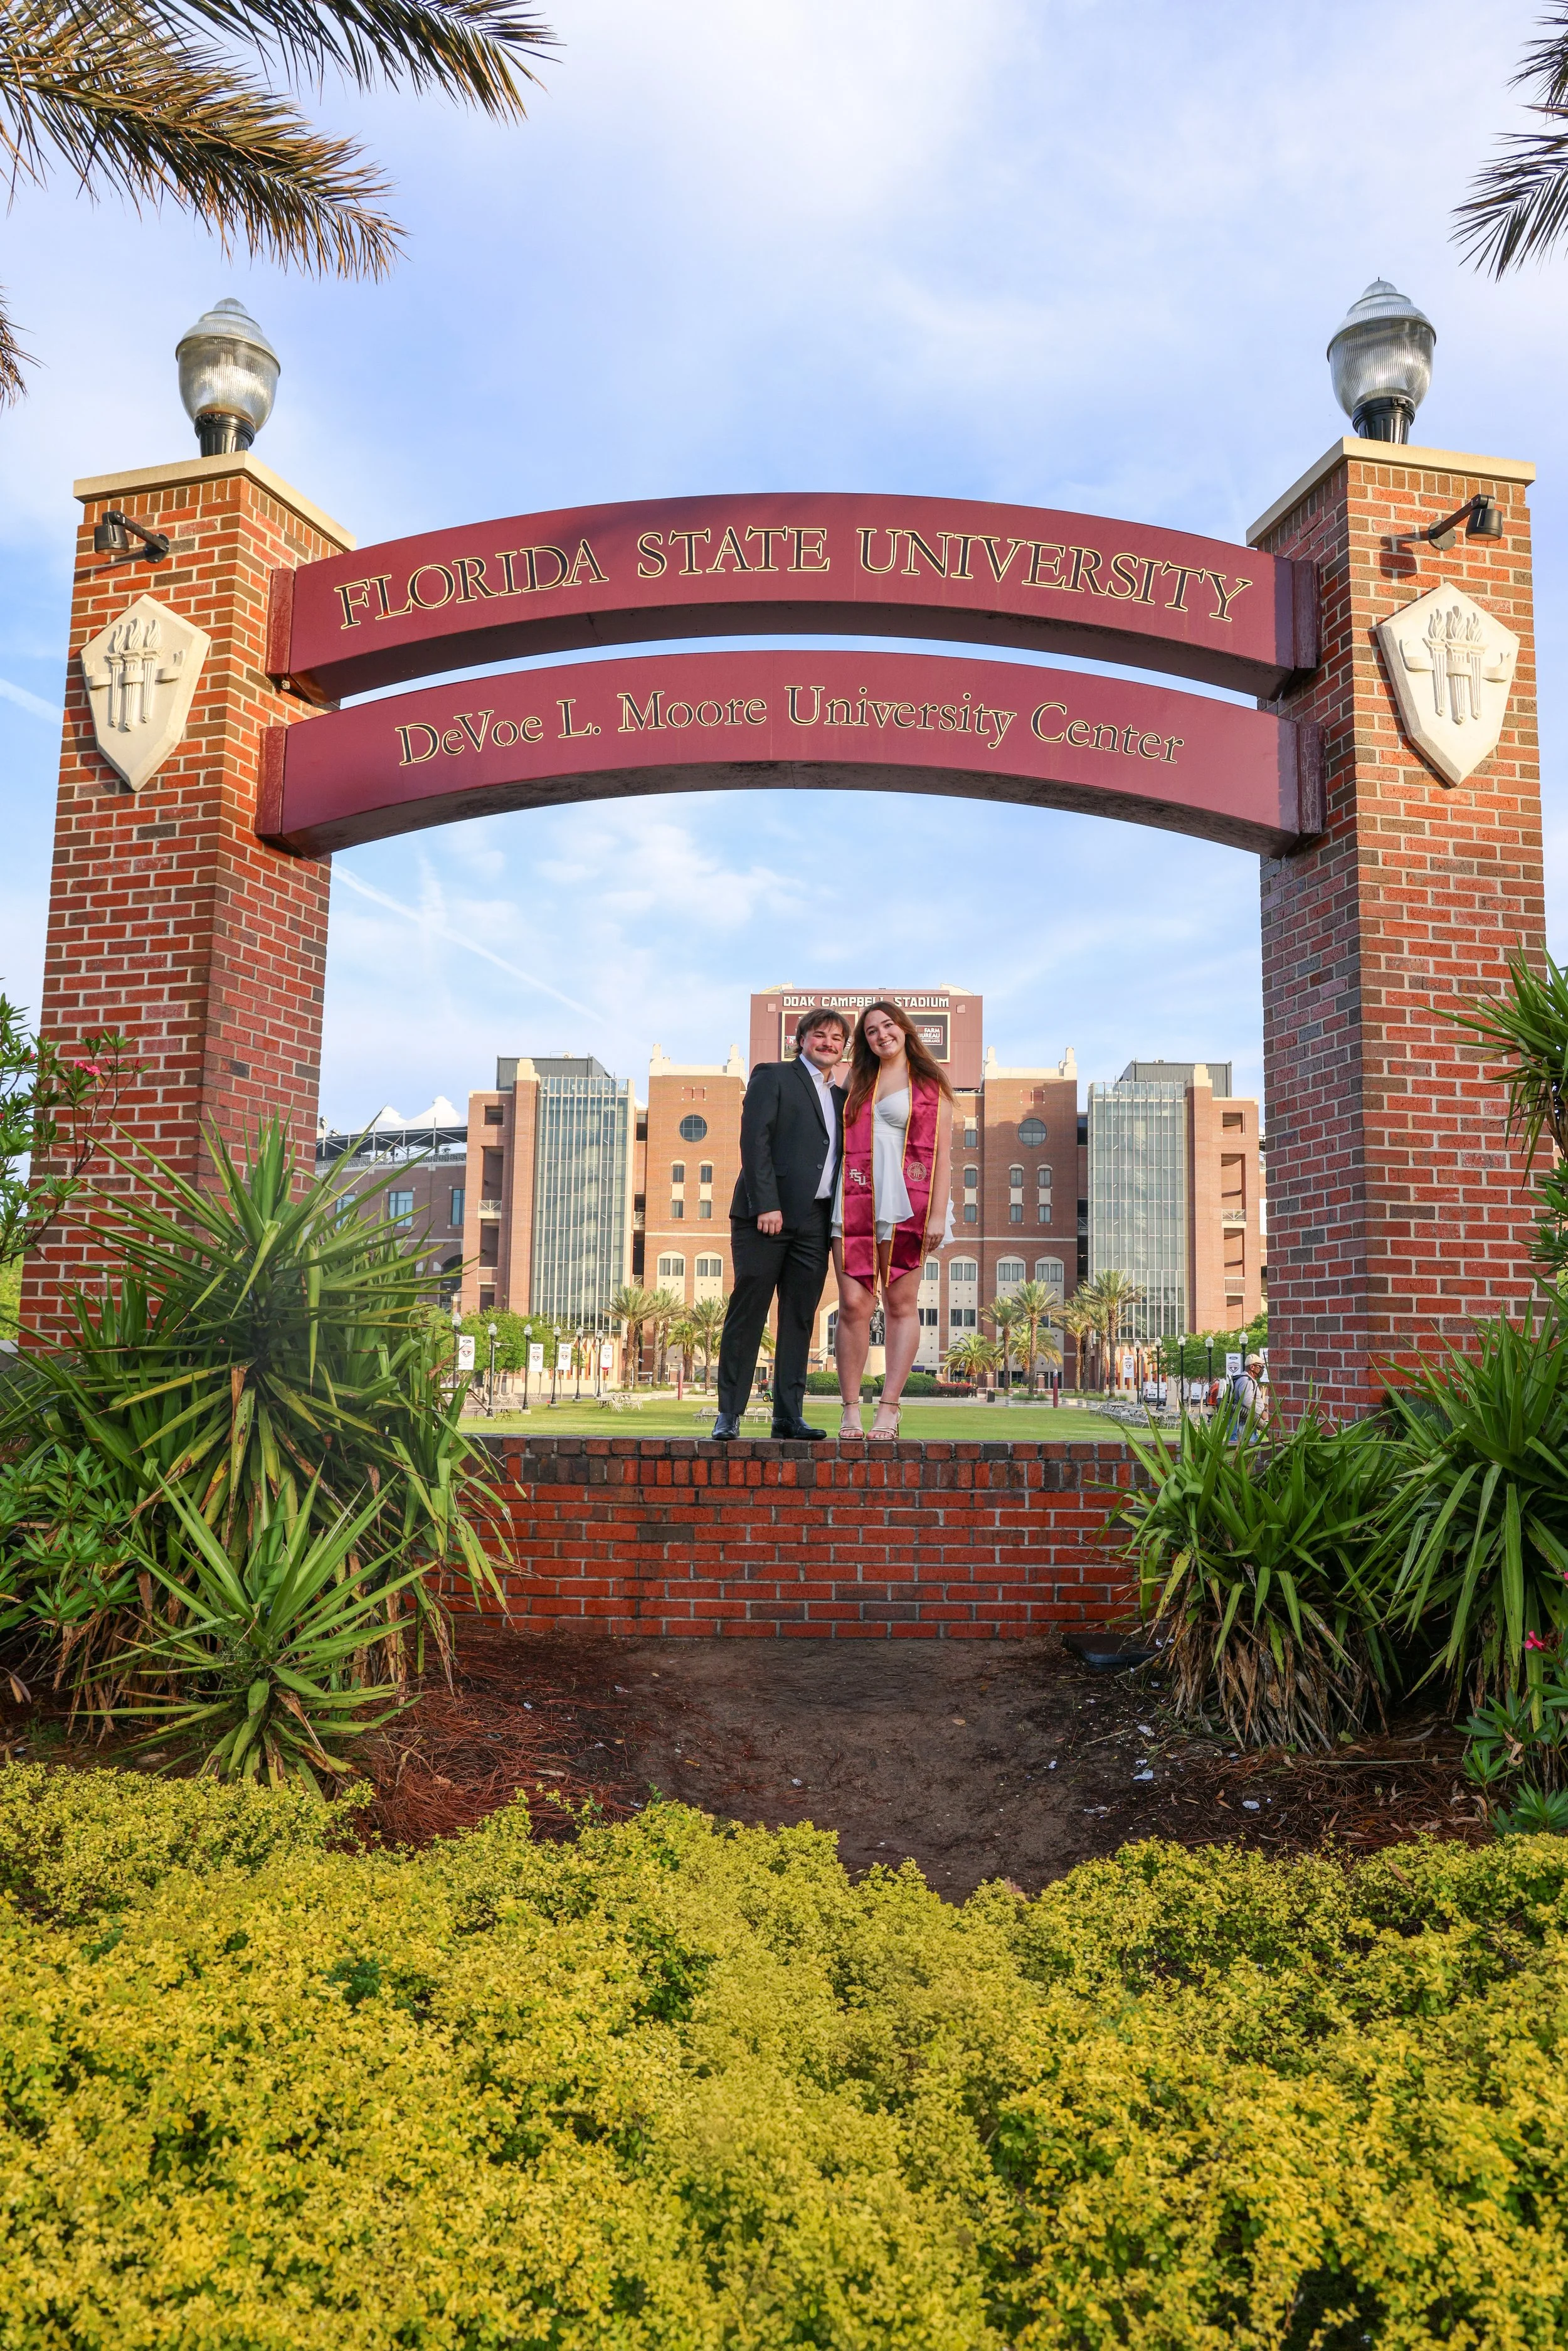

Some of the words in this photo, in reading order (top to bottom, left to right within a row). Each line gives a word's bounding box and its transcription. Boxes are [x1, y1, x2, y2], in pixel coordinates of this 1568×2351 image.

[334, 539, 609, 629] FLORIDA
[638, 526, 830, 578] STATE
[857, 528, 1253, 622] UNIVERSITY
[395, 710, 543, 767] DeVoe
[558, 699, 601, 739] L.
[617, 691, 766, 732] Moore
[785, 685, 1017, 748] University
[1031, 702, 1184, 764] Center
[783, 996, 815, 1007] DOAK
[894, 997, 950, 1007] STADIUM
[849, 1169, 866, 1186] FSU
